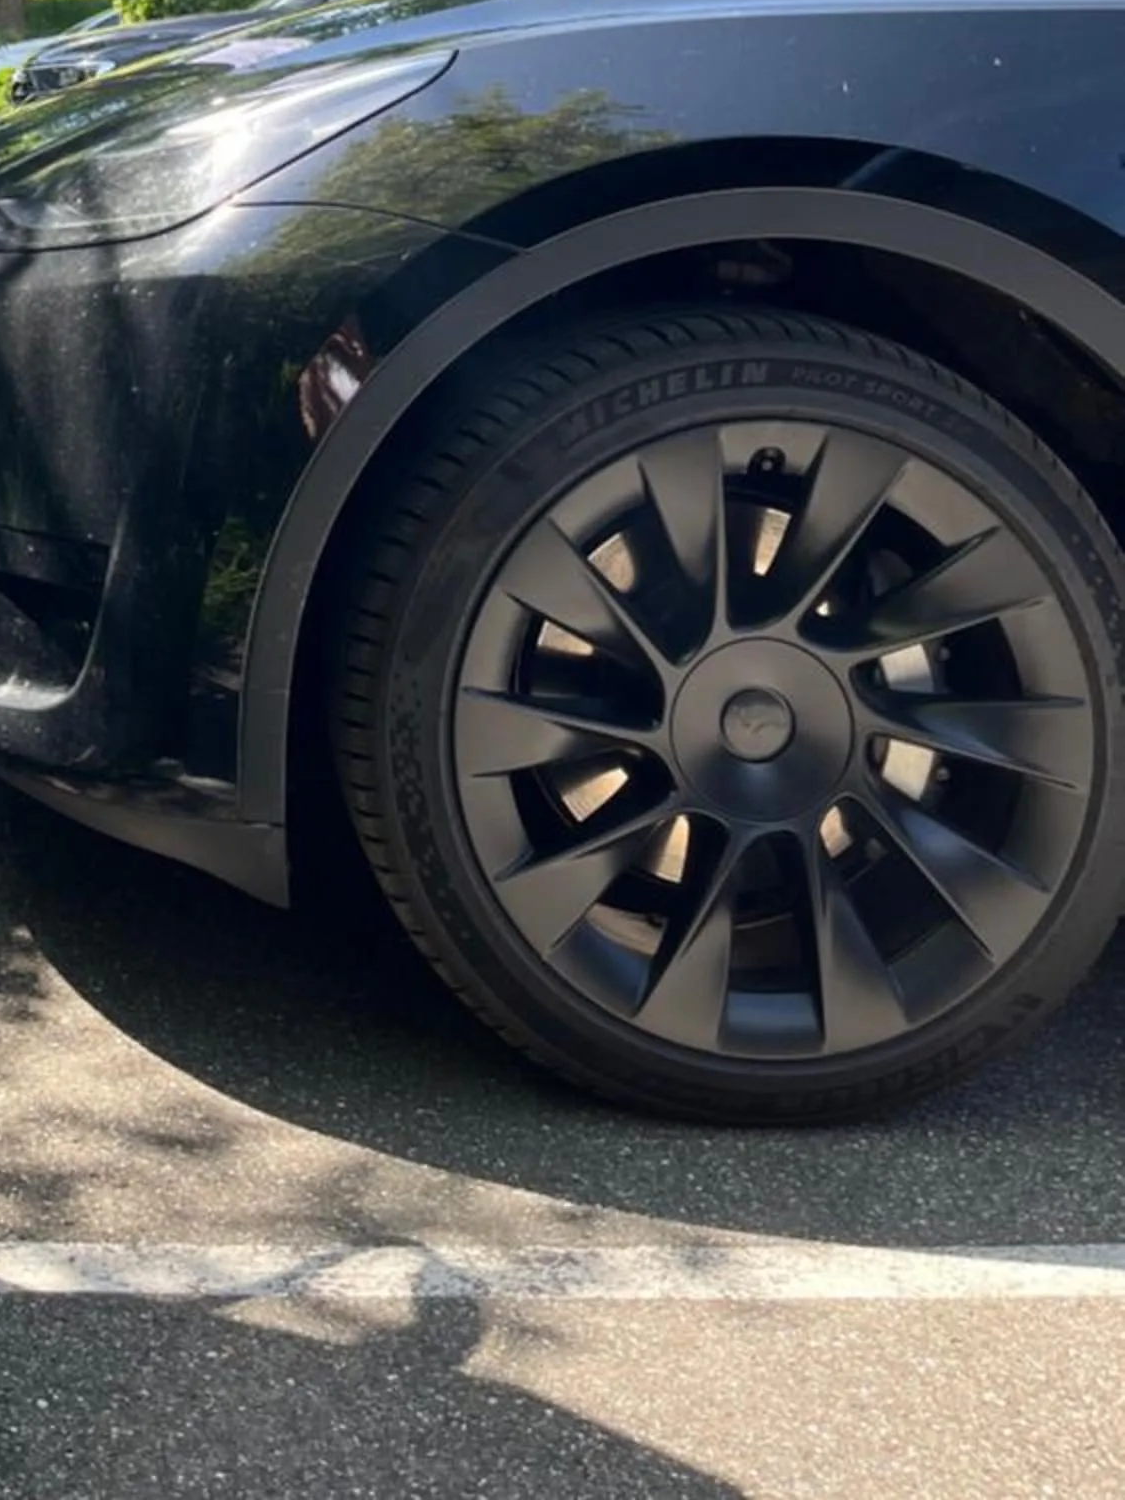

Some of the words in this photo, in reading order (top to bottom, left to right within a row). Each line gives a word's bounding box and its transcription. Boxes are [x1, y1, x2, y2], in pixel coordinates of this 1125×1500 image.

[563, 361, 768, 440] MICHELIN
[792, 366, 858, 389] PILOT
[863, 379, 940, 419] SPORT
